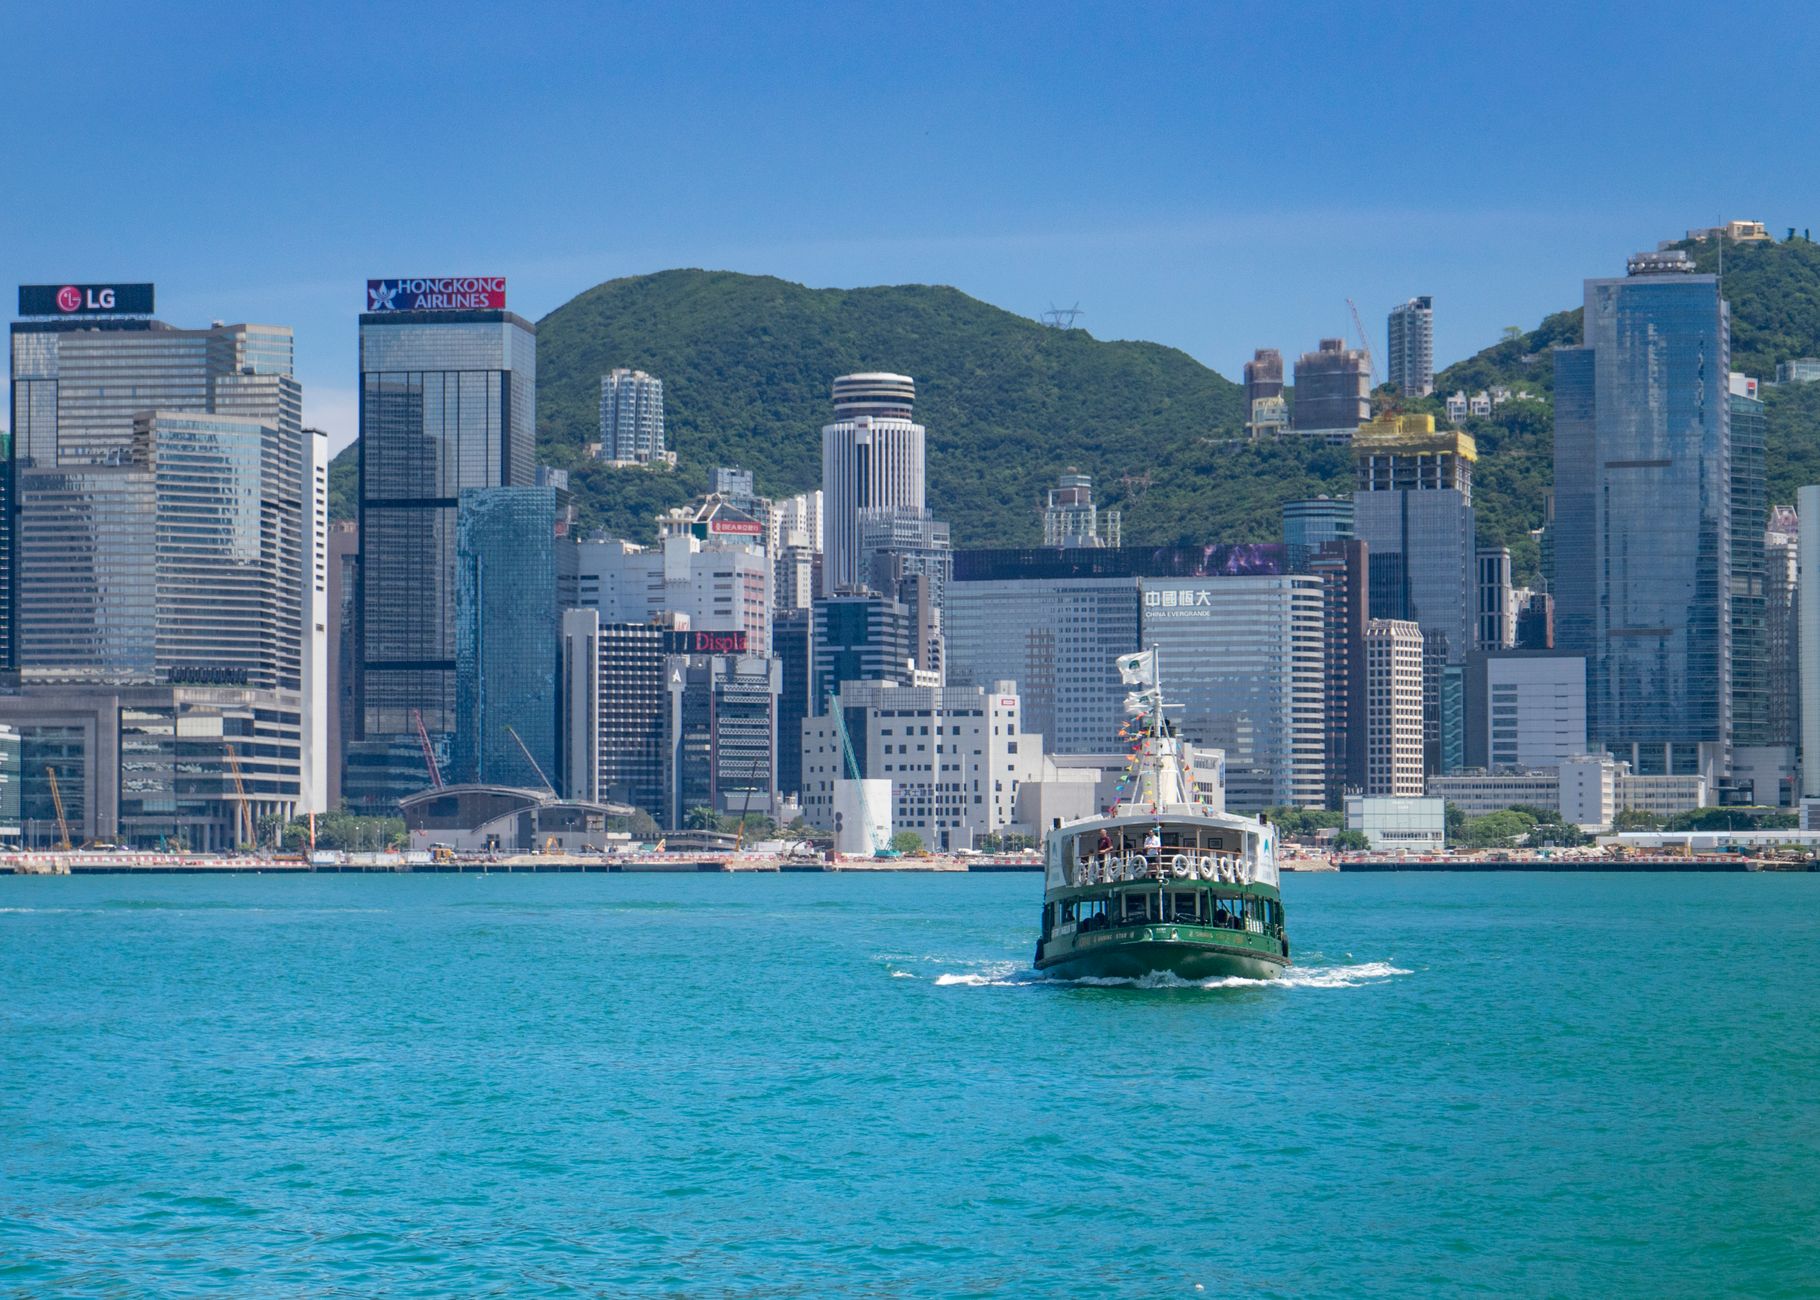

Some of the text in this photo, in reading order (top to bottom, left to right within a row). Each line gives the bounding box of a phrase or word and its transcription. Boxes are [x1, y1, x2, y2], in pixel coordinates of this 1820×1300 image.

[398, 278, 505, 294] HONGKONG
[87, 288, 115, 309] LG
[414, 293, 489, 309] AIRLINES
